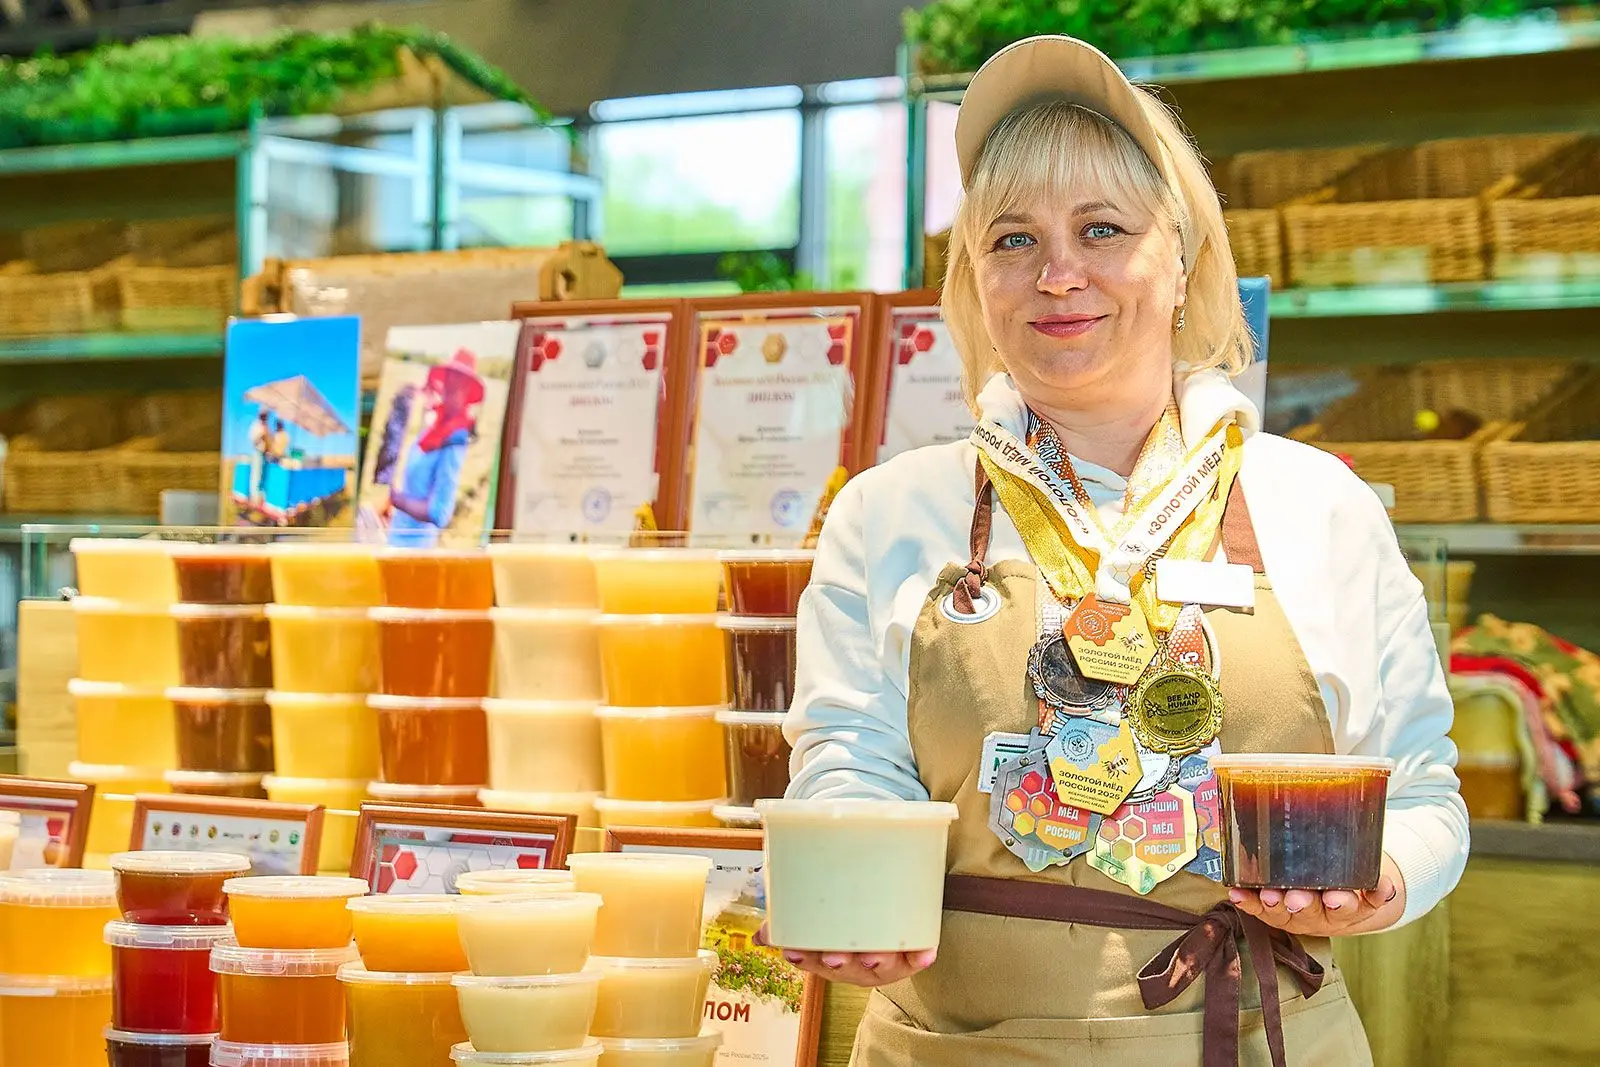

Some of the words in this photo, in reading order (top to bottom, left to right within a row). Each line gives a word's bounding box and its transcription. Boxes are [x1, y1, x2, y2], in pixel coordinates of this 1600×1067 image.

[1002, 441, 1032, 467] МЁД
[1197, 452, 1222, 478] МЁД
[1078, 647, 1121, 661] ЗОЛОТОЙ
[1122, 653, 1143, 665] МЁД
[1079, 656, 1117, 668] РОССИИ
[1118, 662, 1141, 671] 2025
[1167, 694, 1182, 703] BEE
[1183, 691, 1201, 700] AND
[1167, 700, 1198, 710] HUMAN
[1059, 770, 1102, 786] ЗОЛОТОЙ
[1103, 780, 1124, 793] МЁД
[1059, 780, 1097, 793] РОССИИ
[1098, 789, 1121, 801] 2025
[1057, 806, 1079, 820] МЁД
[1140, 801, 1178, 813] ЛУЧШИЙ
[1045, 825, 1081, 840] РОССИИ
[1152, 820, 1174, 834] МЁД
[1143, 843, 1180, 855] РОССИИ
[704, 1001, 750, 1022] ЛОМ
